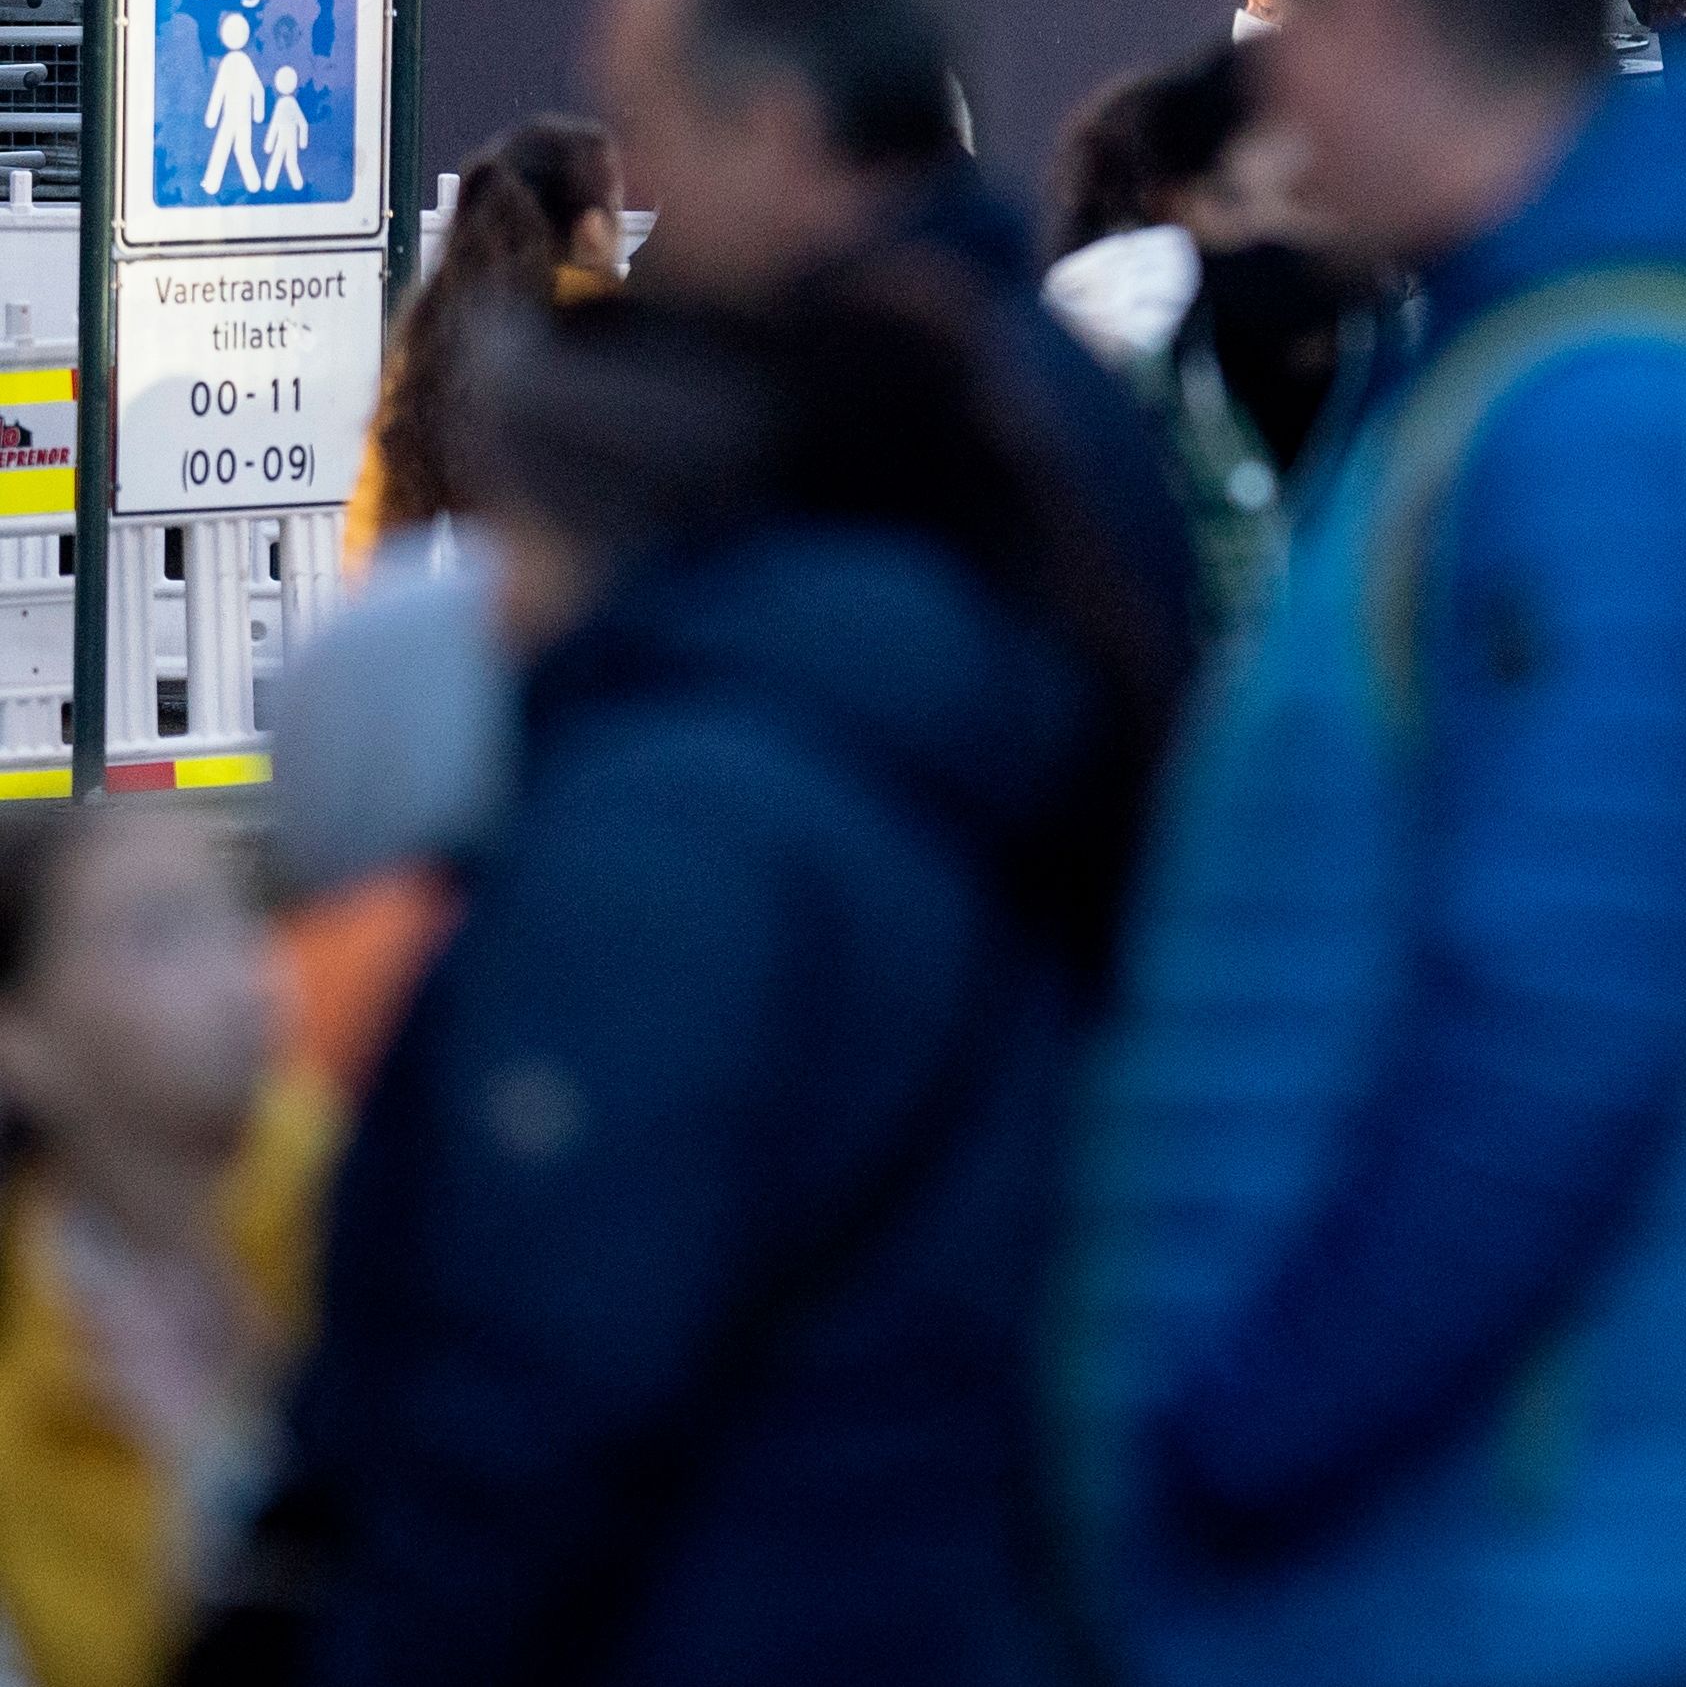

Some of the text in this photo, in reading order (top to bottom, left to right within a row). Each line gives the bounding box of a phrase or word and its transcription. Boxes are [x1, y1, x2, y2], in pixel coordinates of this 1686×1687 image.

[155, 270, 348, 306] Varetransport
[211, 321, 289, 351] tillatt
[182, 444, 316, 492] (00-09)
